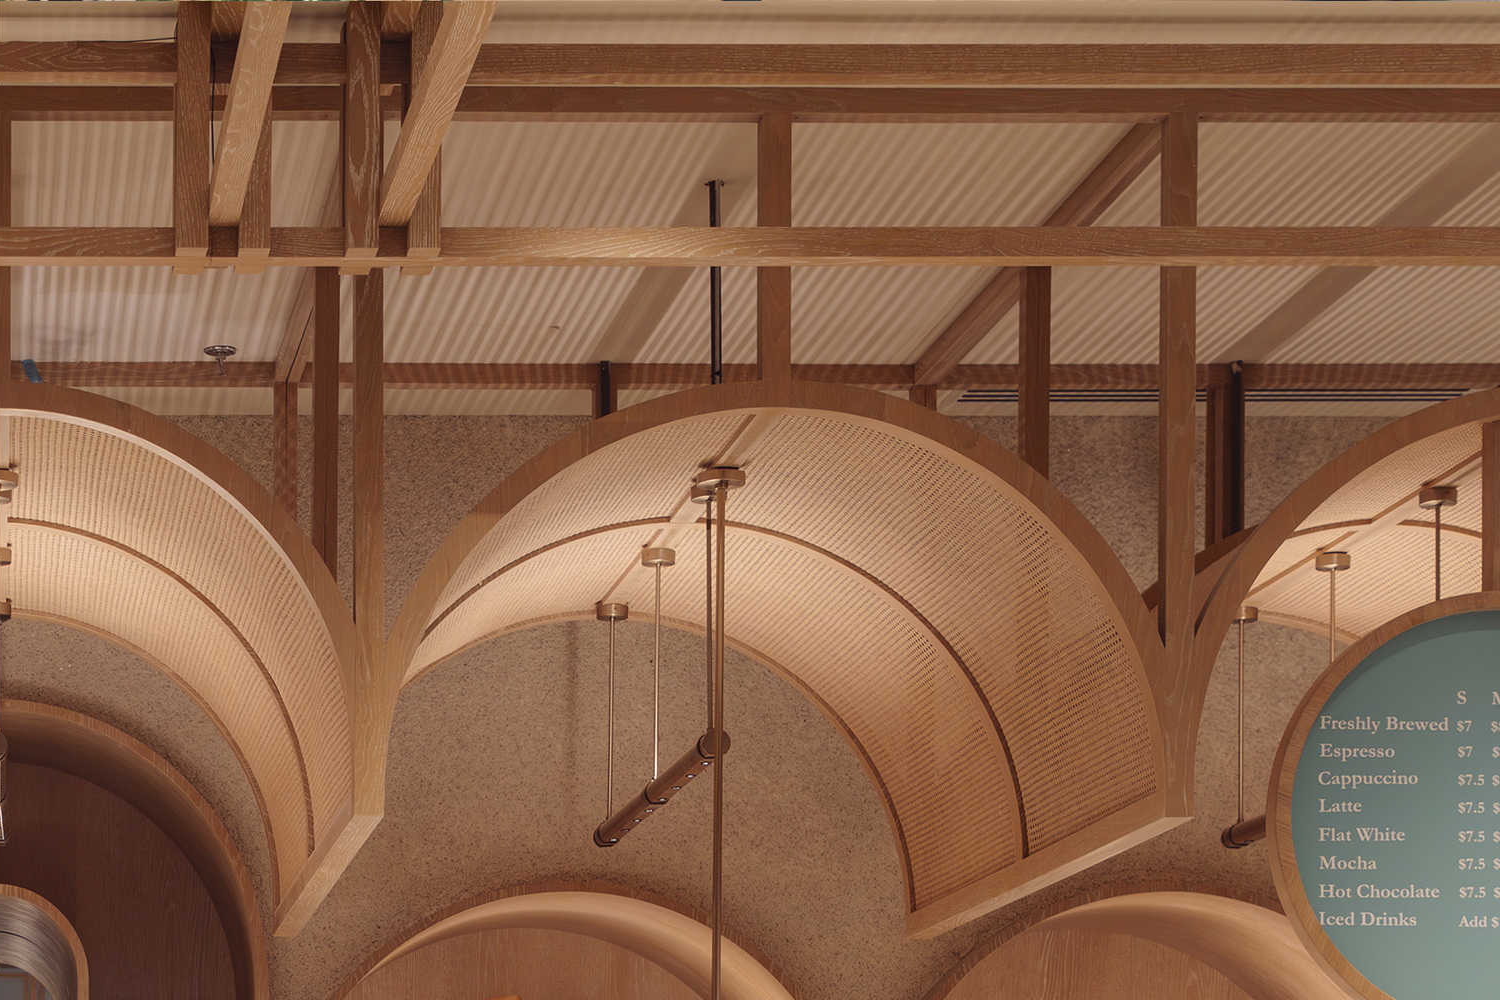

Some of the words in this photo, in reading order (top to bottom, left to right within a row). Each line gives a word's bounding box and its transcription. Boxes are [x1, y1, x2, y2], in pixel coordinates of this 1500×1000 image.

[1457, 690, 1467, 705] S
[1319, 715, 1381, 734] Freshly
[1385, 716, 1449, 731] Brewed
[1456, 720, 1472, 733] $7
[1319, 743, 1396, 762] Espresso
[1457, 746, 1473, 758] $7
[1318, 769, 1419, 789] Cappuccino
[1457, 774, 1485, 786] $7.5
[1318, 798, 1362, 812] Latte
[1458, 802, 1485, 814] $7.5
[1318, 827, 1352, 842] Flat
[1356, 827, 1406, 842] White
[1458, 830, 1485, 843] $7.5
[1319, 855, 1377, 870] Mocha
[1458, 858, 1486, 870] $7.5
[1318, 883, 1352, 898] Hot
[1356, 883, 1440, 898] Chocolate
[1459, 886, 1487, 899] $7.5
[1318, 911, 1355, 926] Iced
[1360, 911, 1417, 927] Drinks
[1458, 915, 1487, 928] Add
